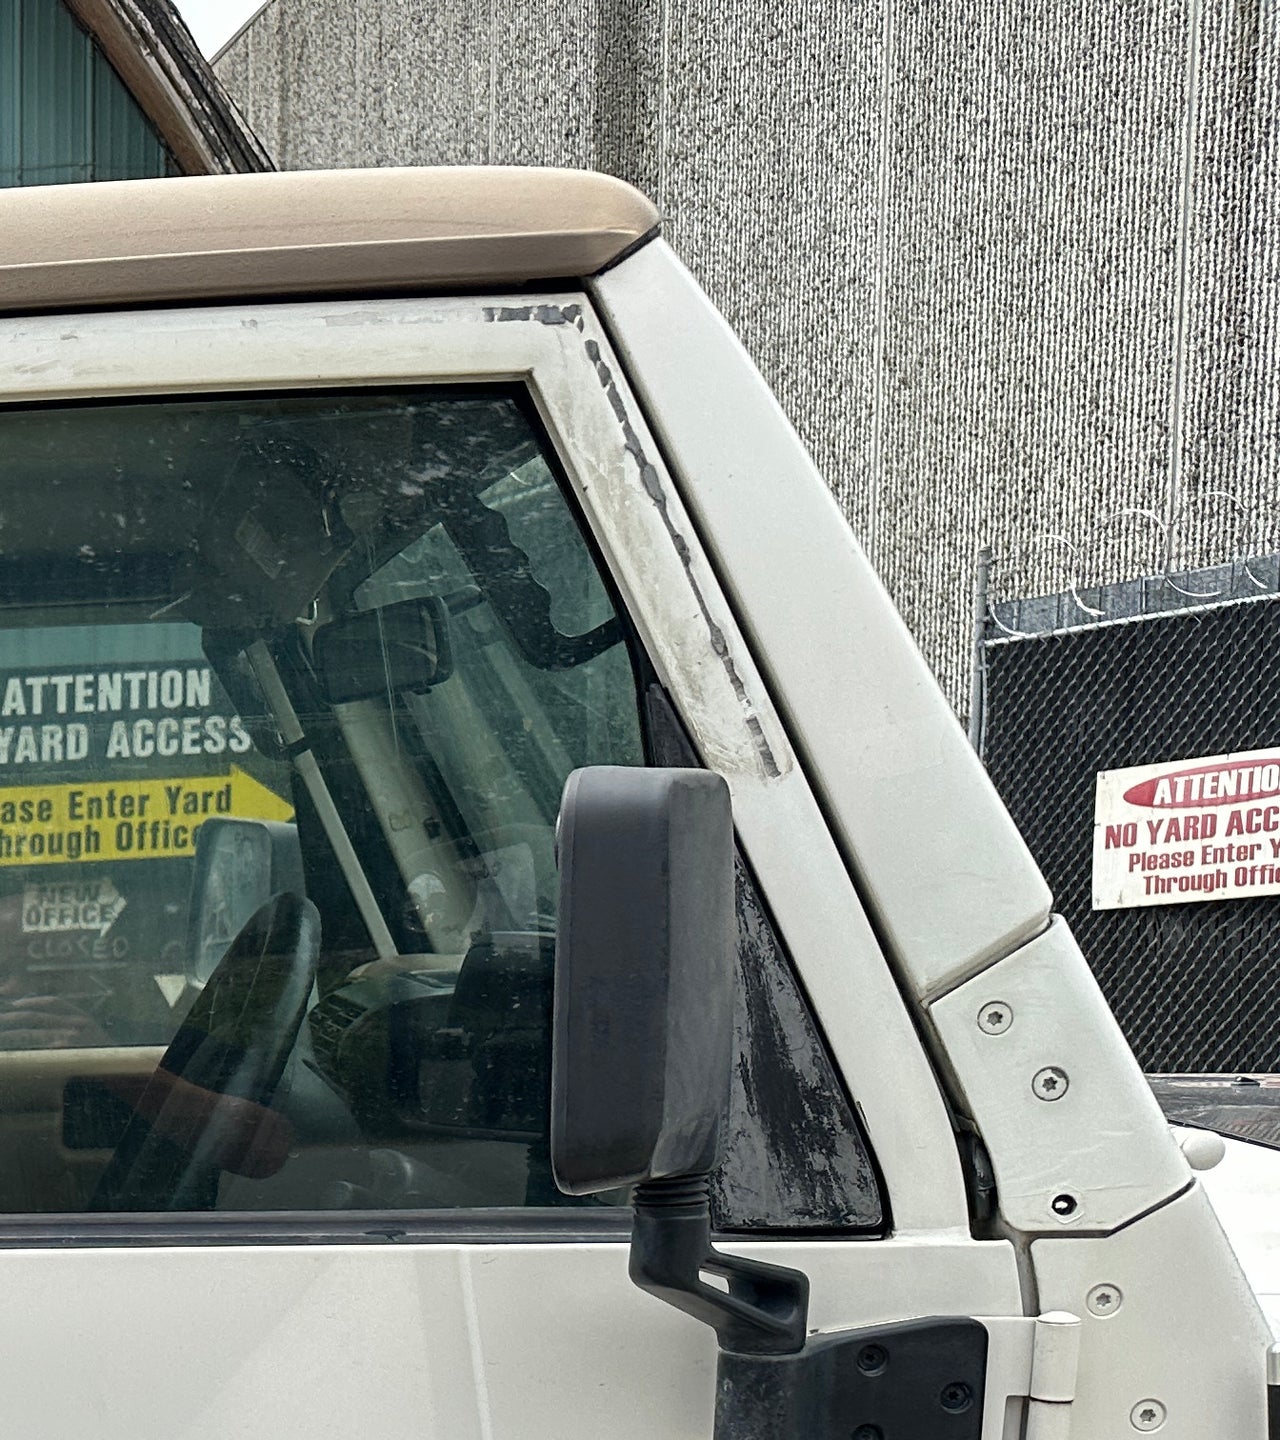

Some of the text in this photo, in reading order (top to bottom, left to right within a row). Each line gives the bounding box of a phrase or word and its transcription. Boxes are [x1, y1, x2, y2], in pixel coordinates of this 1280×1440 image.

[1, 668, 211, 717] ATTENTION
[106, 714, 252, 759] ACCESS
[68, 790, 150, 821] Enter
[164, 784, 233, 815] Yard
[1153, 763, 1280, 806] ATTENTIO
[1105, 805, 1280, 850] NO YARD ACC
[1128, 837, 1280, 873] Please Enter Y
[38, 884, 101, 904] NEW
[1143, 869, 1228, 896] Through
[25, 903, 114, 927] OFFICE
